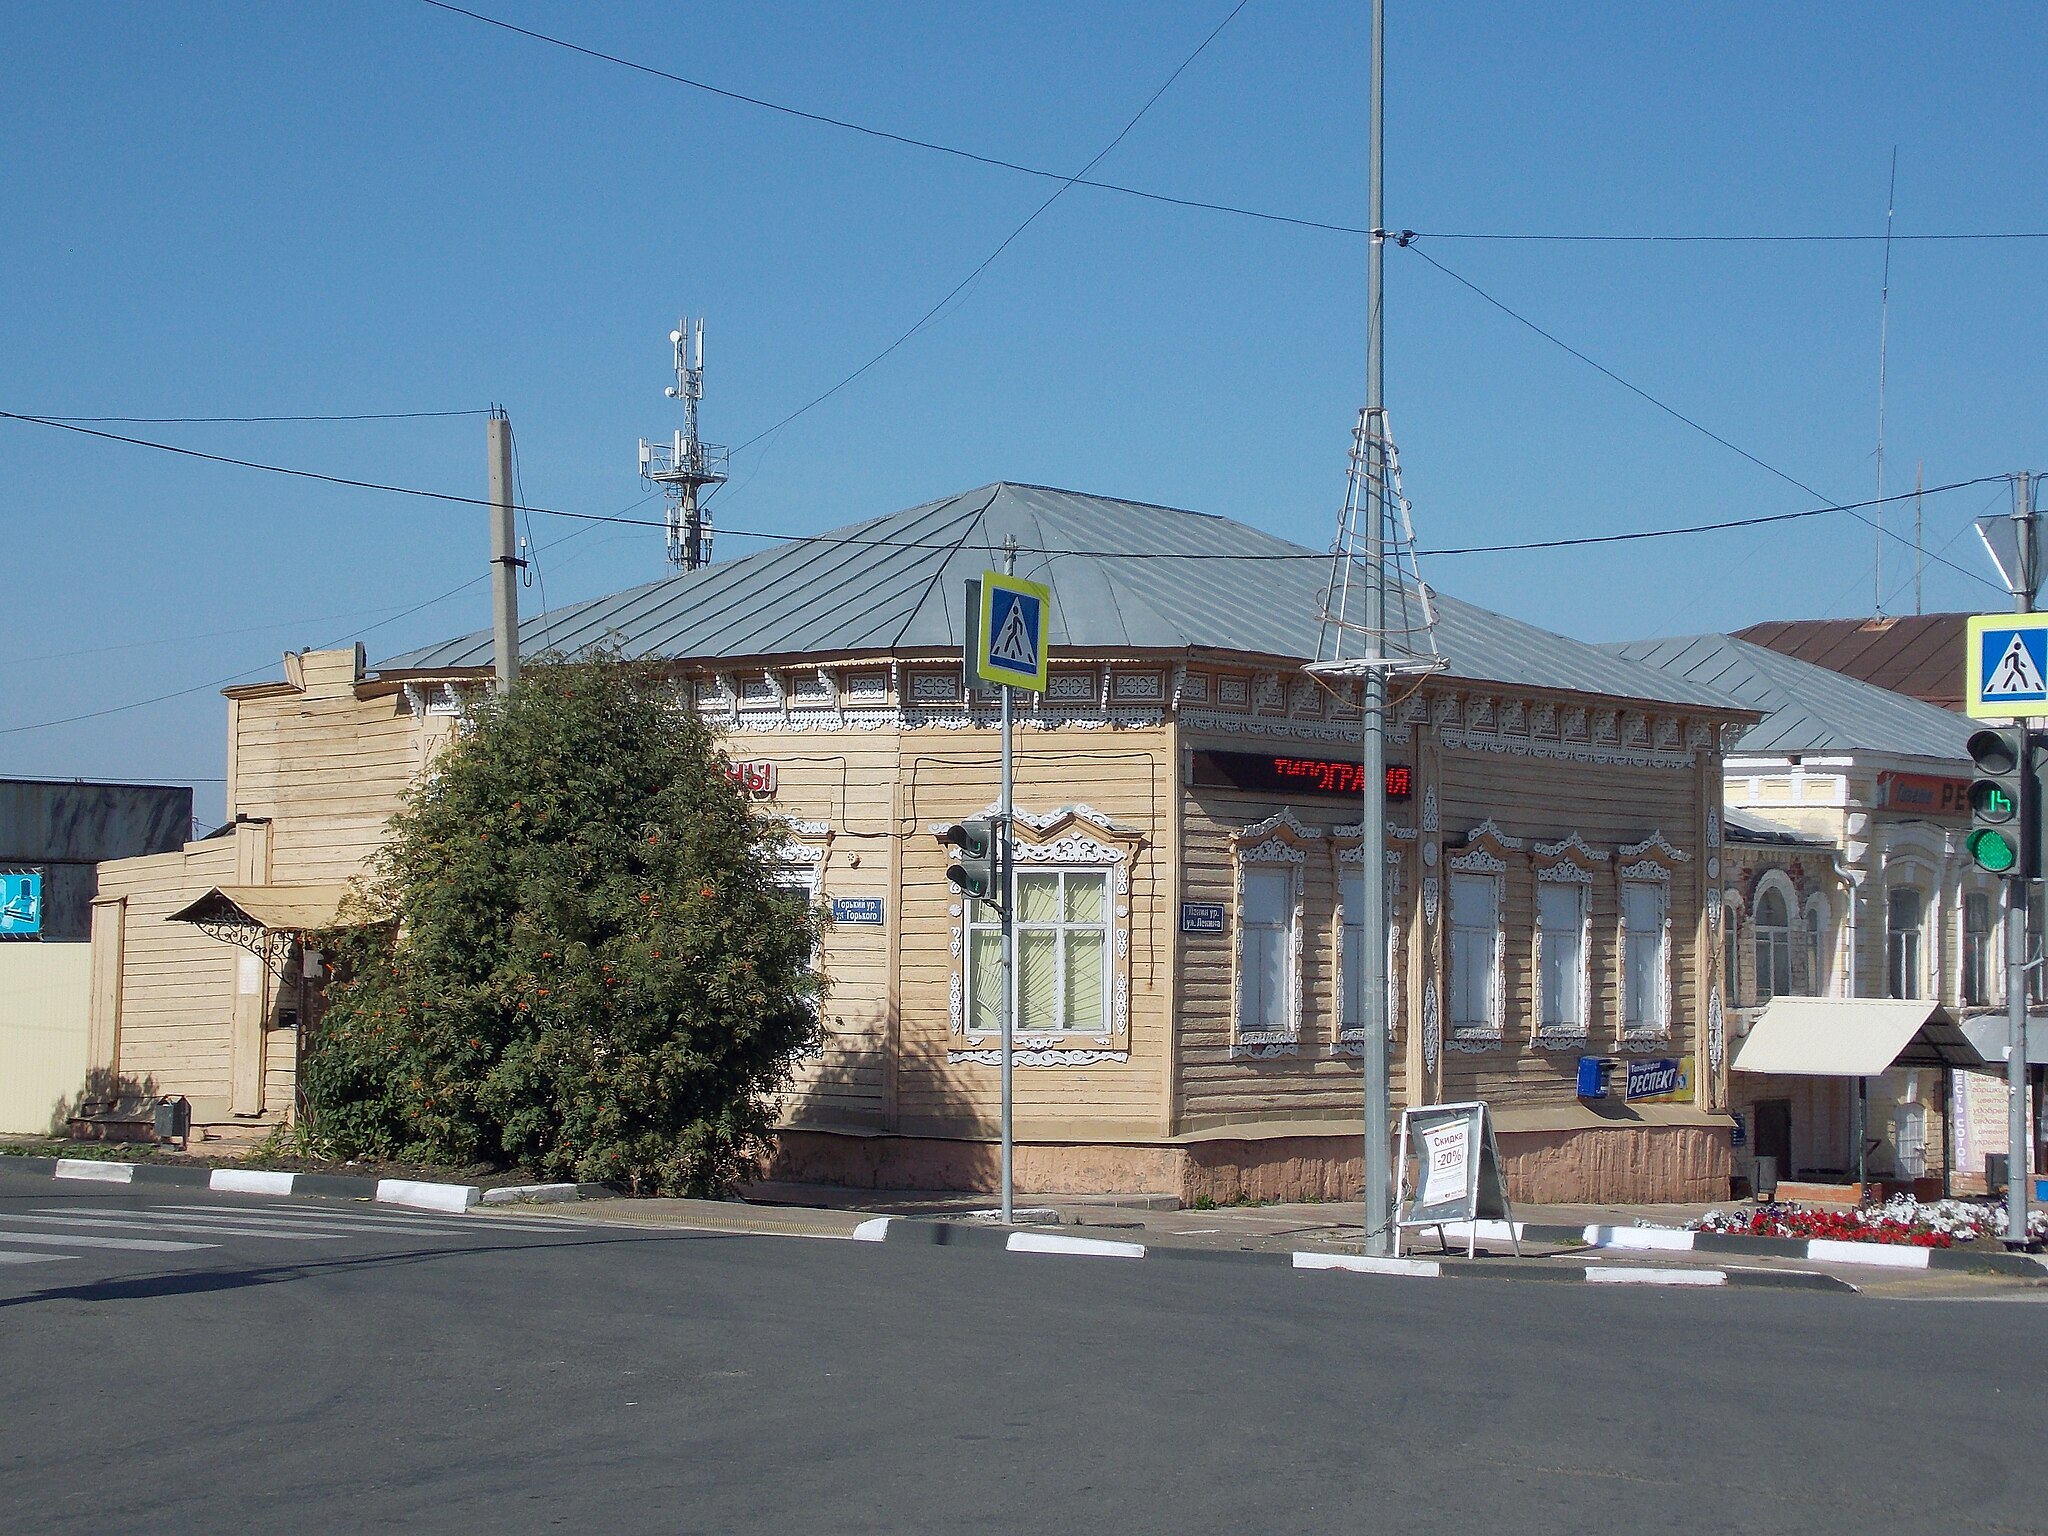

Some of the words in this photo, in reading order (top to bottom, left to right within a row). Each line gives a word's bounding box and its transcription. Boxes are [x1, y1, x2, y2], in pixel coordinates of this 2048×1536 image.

[1274, 759, 1408, 795] ТИПОГРАИЯ
[847, 910, 877, 921] Горького
[1628, 1067, 1676, 1095] РЕСПЕКТ
[1433, 1132, 1464, 1147] Скидка
[1956, 1118, 1966, 1167] СОТОК
[1437, 1149, 1462, 1166] -20%
